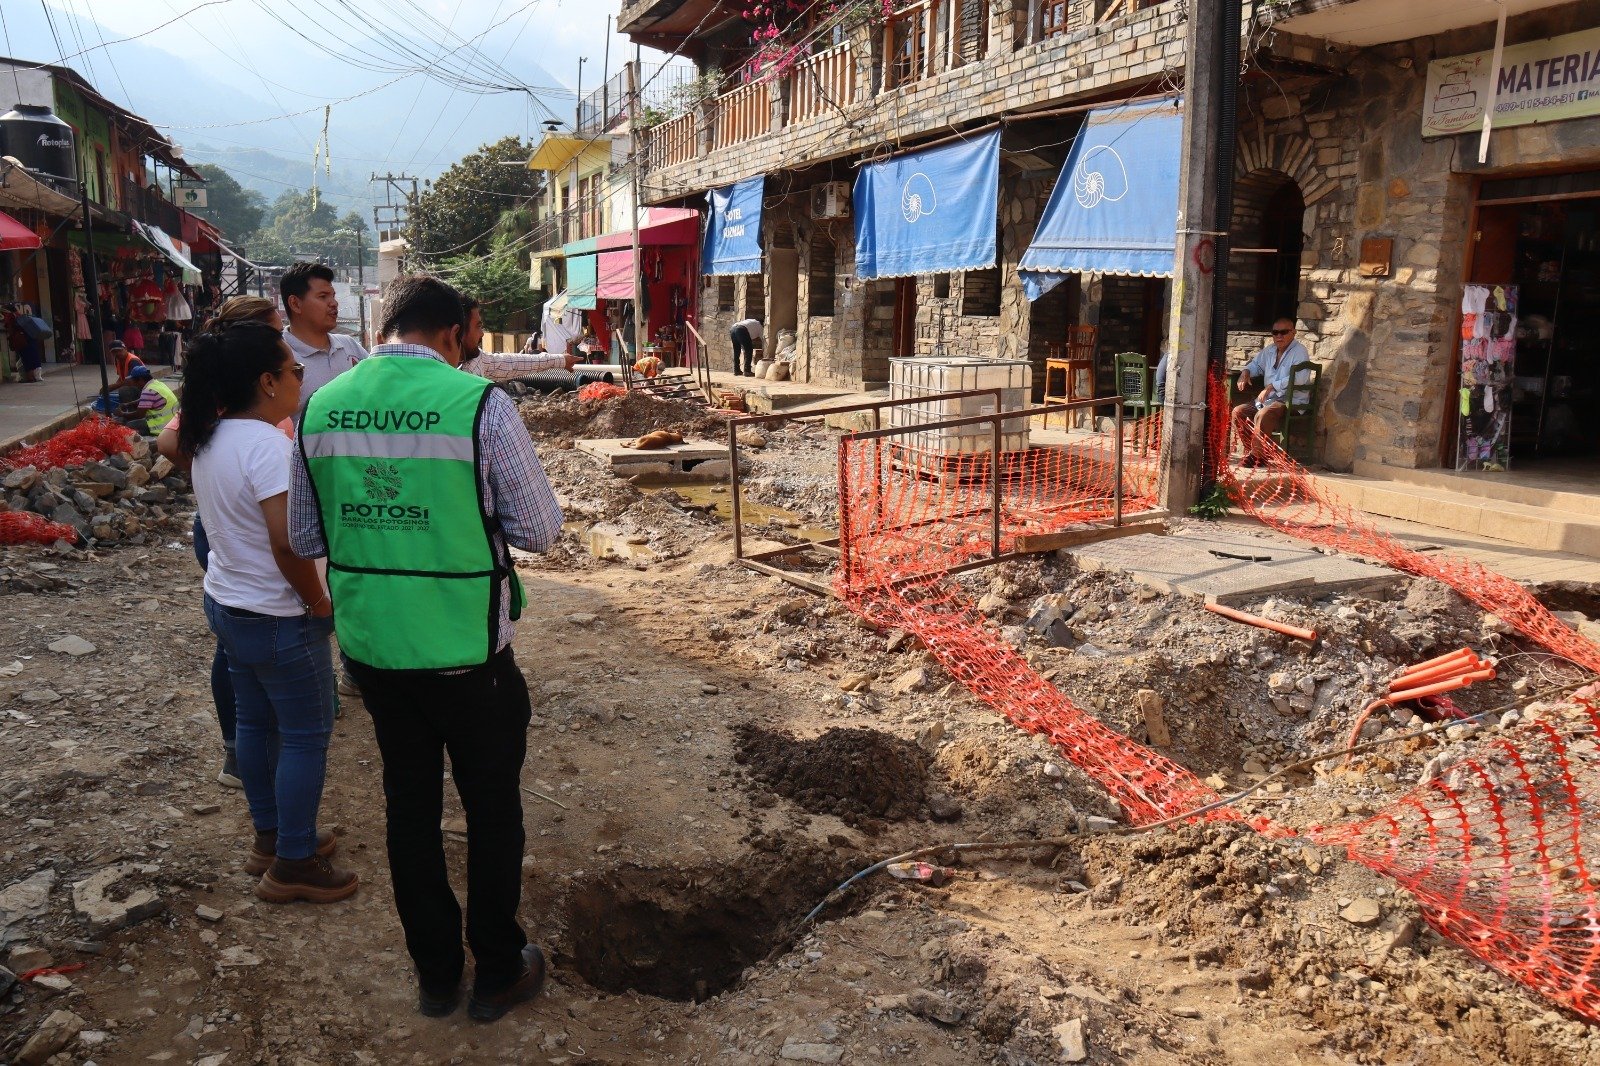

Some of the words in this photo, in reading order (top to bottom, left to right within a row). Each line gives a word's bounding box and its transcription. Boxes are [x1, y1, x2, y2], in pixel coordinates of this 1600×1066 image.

[1497, 49, 1600, 95] MATERIA
[41, 139, 70, 148] Rotoplas
[327, 410, 441, 430] SEDUVOP
